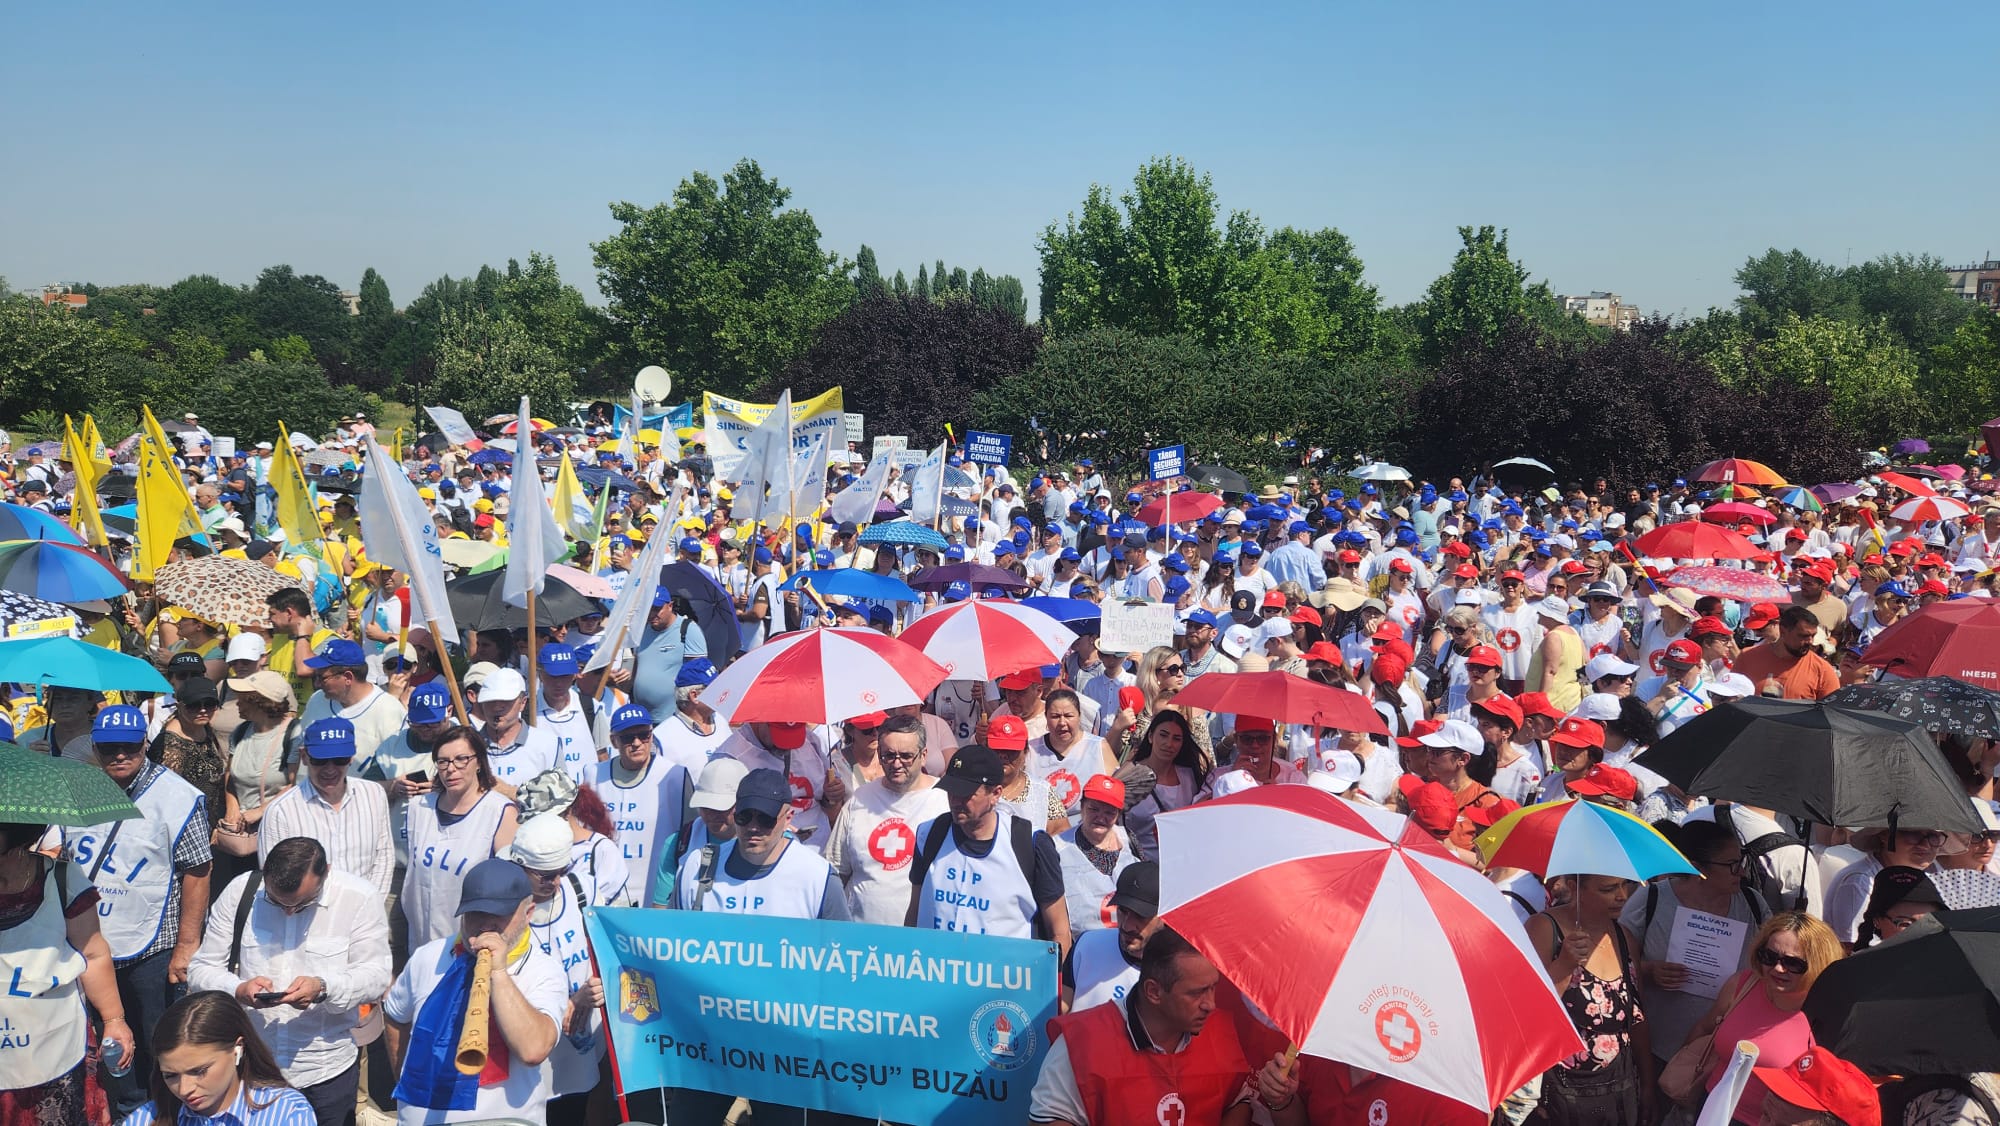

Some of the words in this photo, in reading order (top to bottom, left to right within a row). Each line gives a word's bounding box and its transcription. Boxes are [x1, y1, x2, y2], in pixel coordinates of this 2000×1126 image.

[976, 434, 1001, 446] TÂRGU
[969, 443, 1005, 454] SECUIESC
[970, 453, 1002, 463] COVASNA
[1153, 457, 1181, 469] SECUIESC
[176, 656, 200, 664] STYLE
[550, 652, 572, 662] FSLI
[1961, 669, 1998, 679] INESIS
[416, 695, 444, 707] FSLI
[101, 711, 138, 729] FSLI
[619, 710, 644, 721] FSLI
[320, 729, 347, 741] FSLI
[67, 835, 149, 883] SLI
[934, 888, 990, 912] BUZAU
[615, 934, 773, 968] SINDICATUL
[780, 938, 1033, 991] ÎNVĂȚĂMÂNTULUI
[1358, 984, 1390, 1014] Sunteți
[1392, 986, 1434, 1018] protejați
[1428, 1021, 1440, 1037] de
[698, 995, 940, 1039] PREUNIVERSITAR
[721, 1046, 766, 1072] ION
[912, 1067, 1010, 1103] BUZĂU
